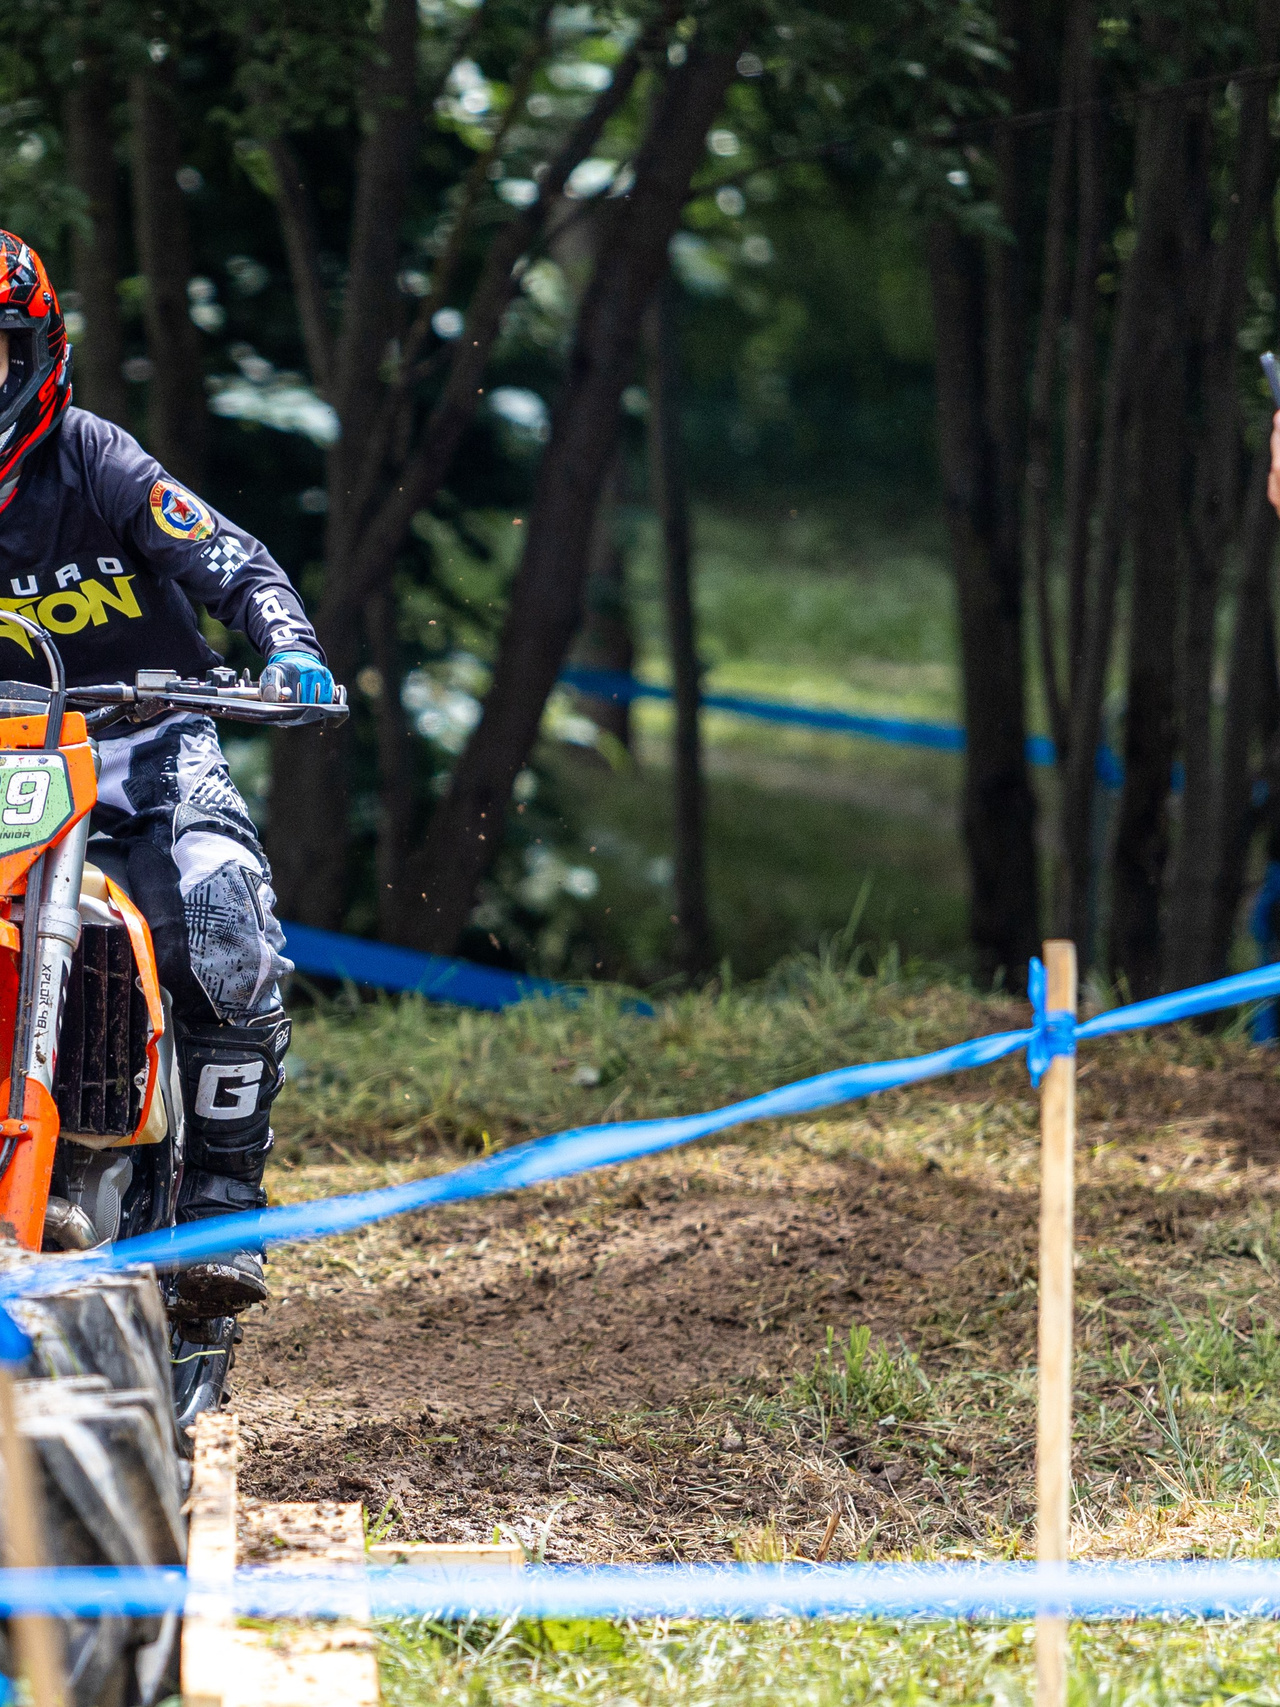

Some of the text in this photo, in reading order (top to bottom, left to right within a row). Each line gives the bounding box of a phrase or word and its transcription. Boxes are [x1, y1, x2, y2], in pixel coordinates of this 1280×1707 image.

[37, 963, 52, 1029] XPLOR 48
[194, 1060, 264, 1120] G
